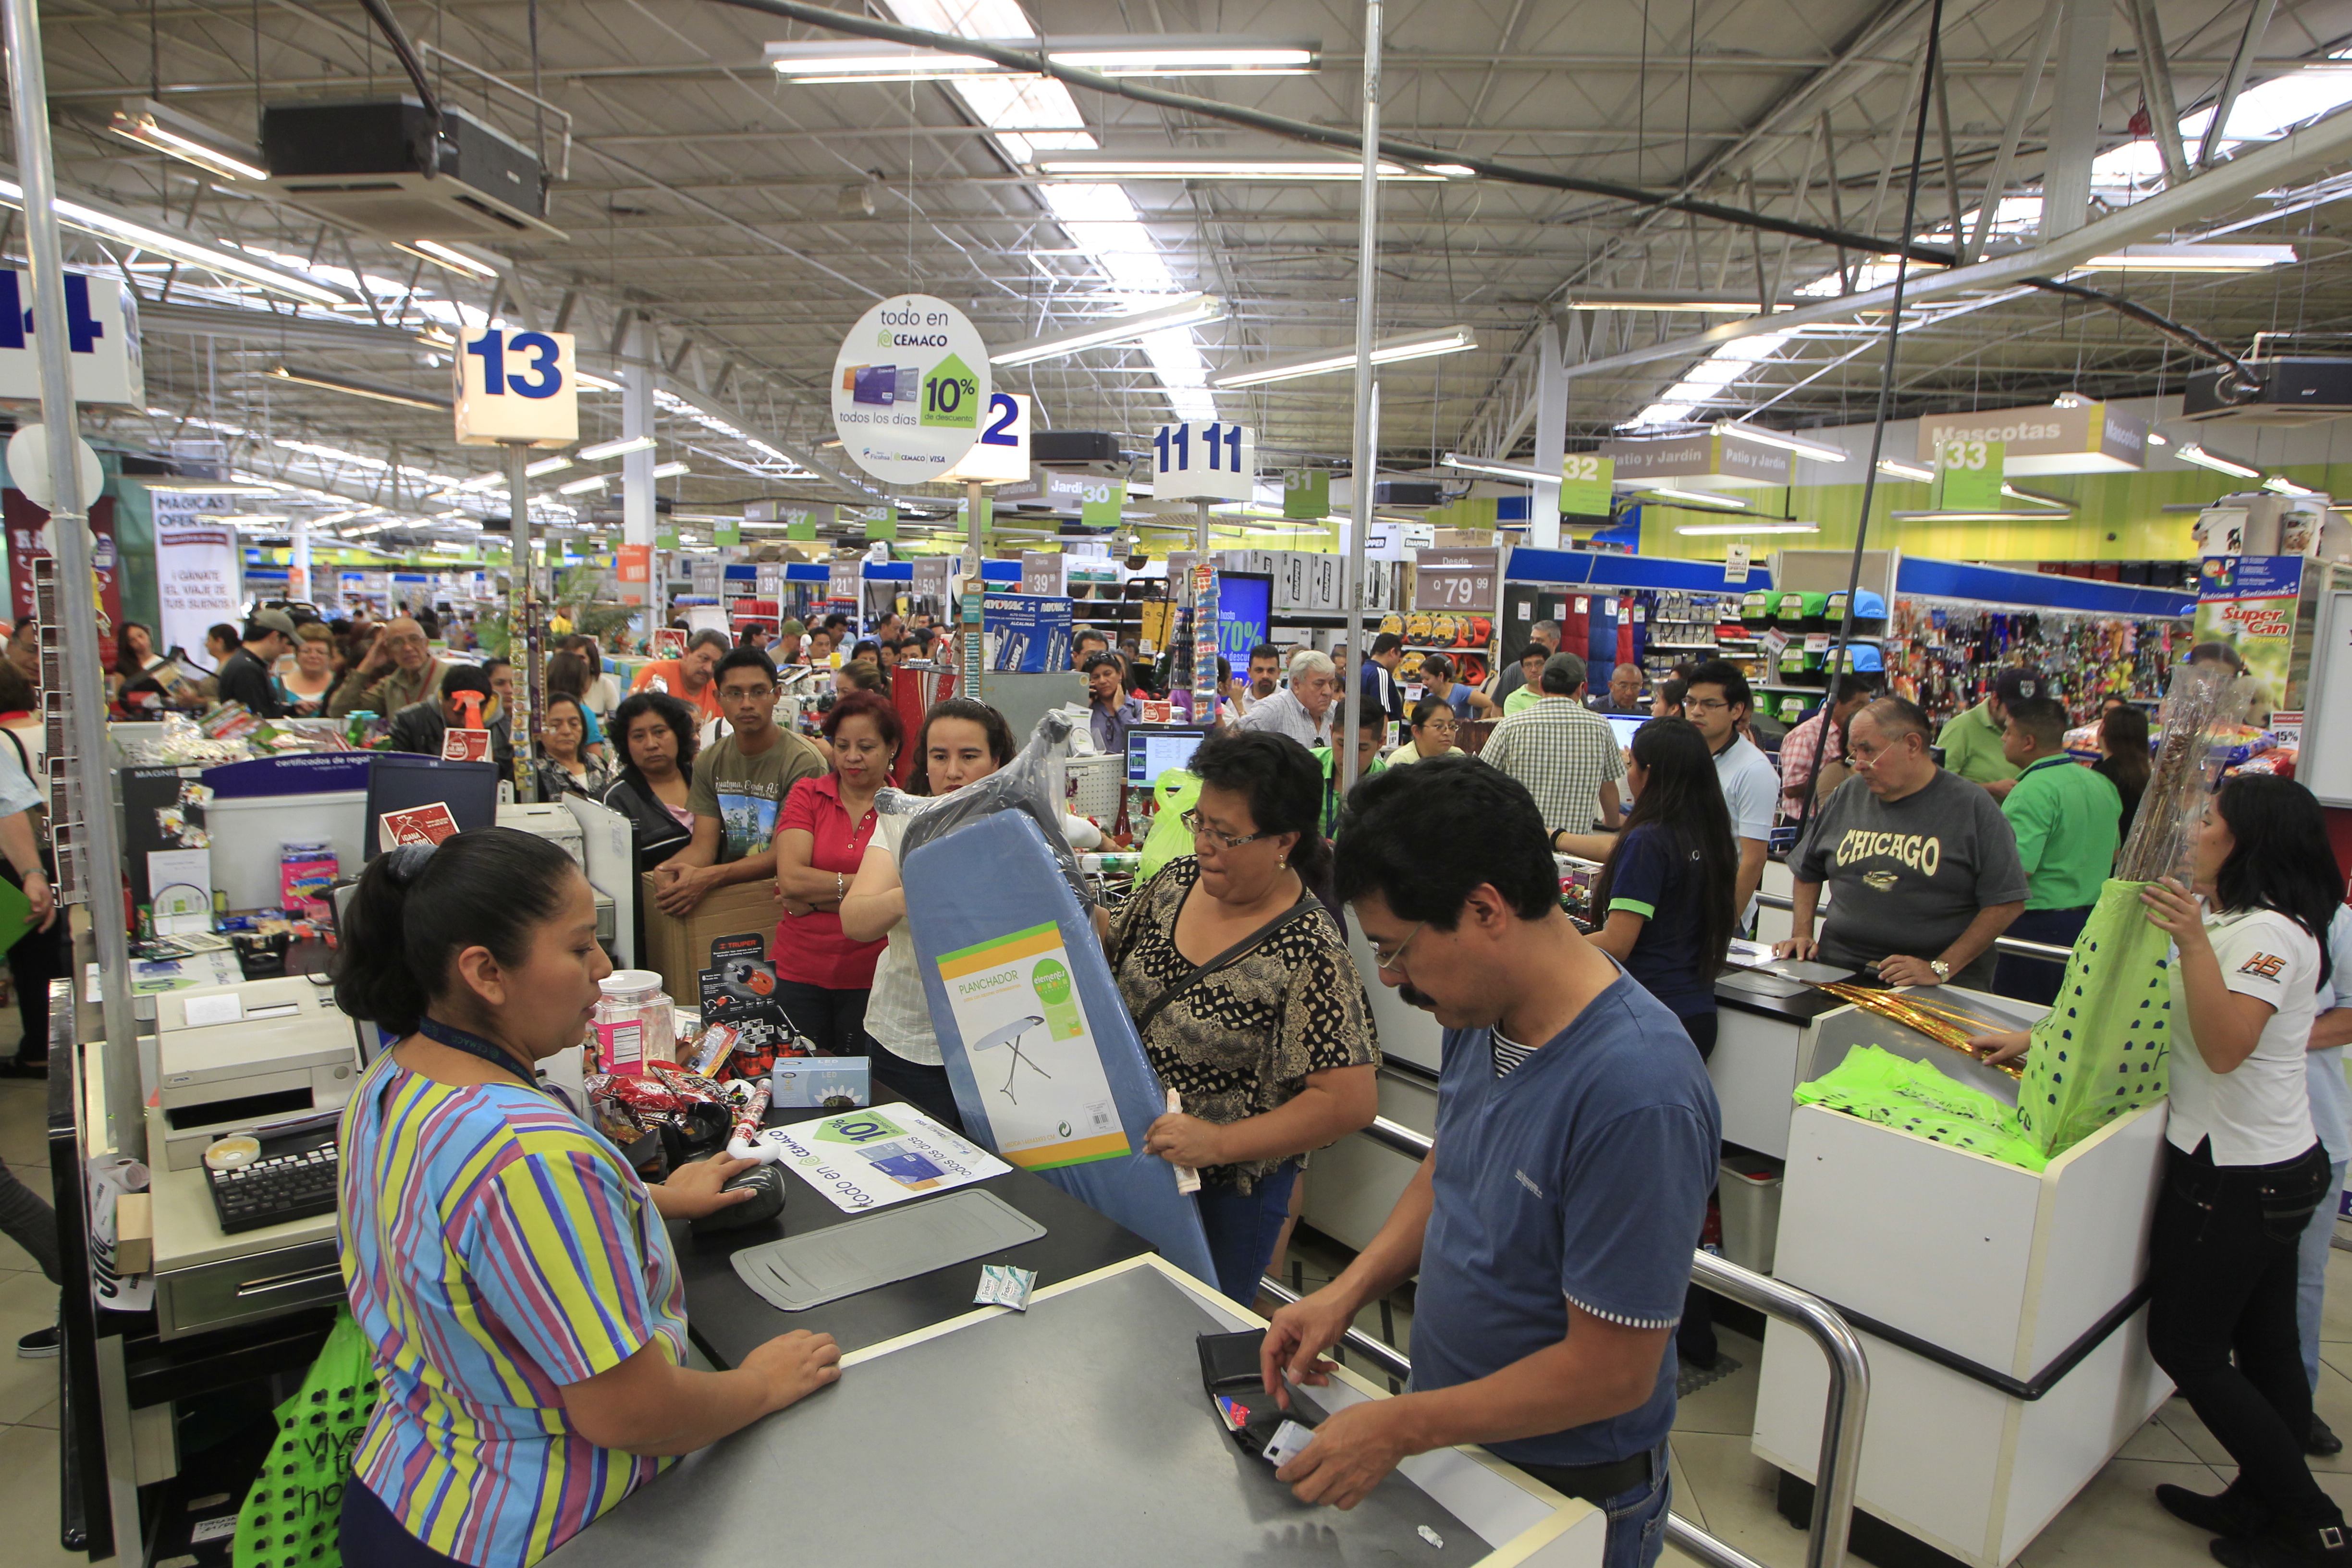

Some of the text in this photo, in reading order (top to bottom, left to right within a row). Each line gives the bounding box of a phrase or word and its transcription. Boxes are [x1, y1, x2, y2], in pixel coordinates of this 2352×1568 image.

[881, 308, 949, 326] todo en
[894, 334, 947, 346] CEMACO
[467, 331, 563, 399] 13
[926, 378, 975, 413] 10%
[840, 412, 917, 425] todos los días
[936, 414, 973, 422] descuento
[974, 392, 1018, 447] 2
[1932, 422, 2061, 446] Mascotas
[2106, 418, 2141, 450] Mascotas
[1154, 423, 1188, 473] 11
[1202, 422, 1241, 473] 11
[1947, 441, 1987, 470] 33
[1646, 455, 1653, 466] y
[1658, 449, 1702, 465] Jardín
[1726, 449, 1786, 470] Patio y Jardín
[1562, 458, 1599, 480] 32
[1051, 479, 1083, 494] Jardi
[1284, 470, 1312, 490] 31
[1083, 485, 1110, 503] 30
[866, 506, 888, 521] 28
[958, 498, 969, 512] 2
[159, 514, 196, 527] OFER
[714, 519, 733, 531] 26
[787, 509, 808, 524] 27
[1406, 539, 1429, 547] SNAPPER
[1442, 557, 1469, 565] Desde
[2224, 558, 2236, 571] P
[836, 577, 847, 592] 21
[922, 578, 935, 594] 59
[1033, 574, 1049, 592] 39
[1049, 574, 1056, 582] 99
[1293, 558, 1301, 600] SNAPPER
[1323, 563, 1331, 602] SNAPPER
[2220, 574, 2231, 586] L
[164, 584, 179, 595] EL
[1433, 578, 1488, 603] Q 79 99
[983, 599, 1025, 611] AYOVAC
[1040, 602, 1066, 613] RAYOVAC
[1220, 609, 1236, 620] hasta
[2221, 604, 2286, 624] Super
[1219, 621, 1263, 652] 70%
[2248, 621, 2291, 637] Can
[1228, 653, 1250, 662] descue
[2275, 731, 2299, 742] 15%
[275, 754, 374, 767] certificados de regal
[1130, 757, 1145, 766] 70%
[134, 769, 177, 778] MAGNE
[1836, 828, 1941, 877] CHICAGO
[727, 940, 758, 948] TRUPER
[2241, 951, 2287, 977] HS
[958, 969, 1019, 995] PLANCHADOR
[1033, 969, 1066, 985] elements
[865, 1113, 892, 1130] descuento
[828, 1119, 888, 1142] 10%
[769, 1130, 810, 1157] CEMACO
[907, 1136, 931, 1150] días
[928, 1150, 947, 1161] los
[816, 1166, 874, 1206] todo en
[981, 1279, 992, 1296] Trident
[1001, 1280, 1014, 1298] Trident
[304, 1426, 367, 1458] vive
